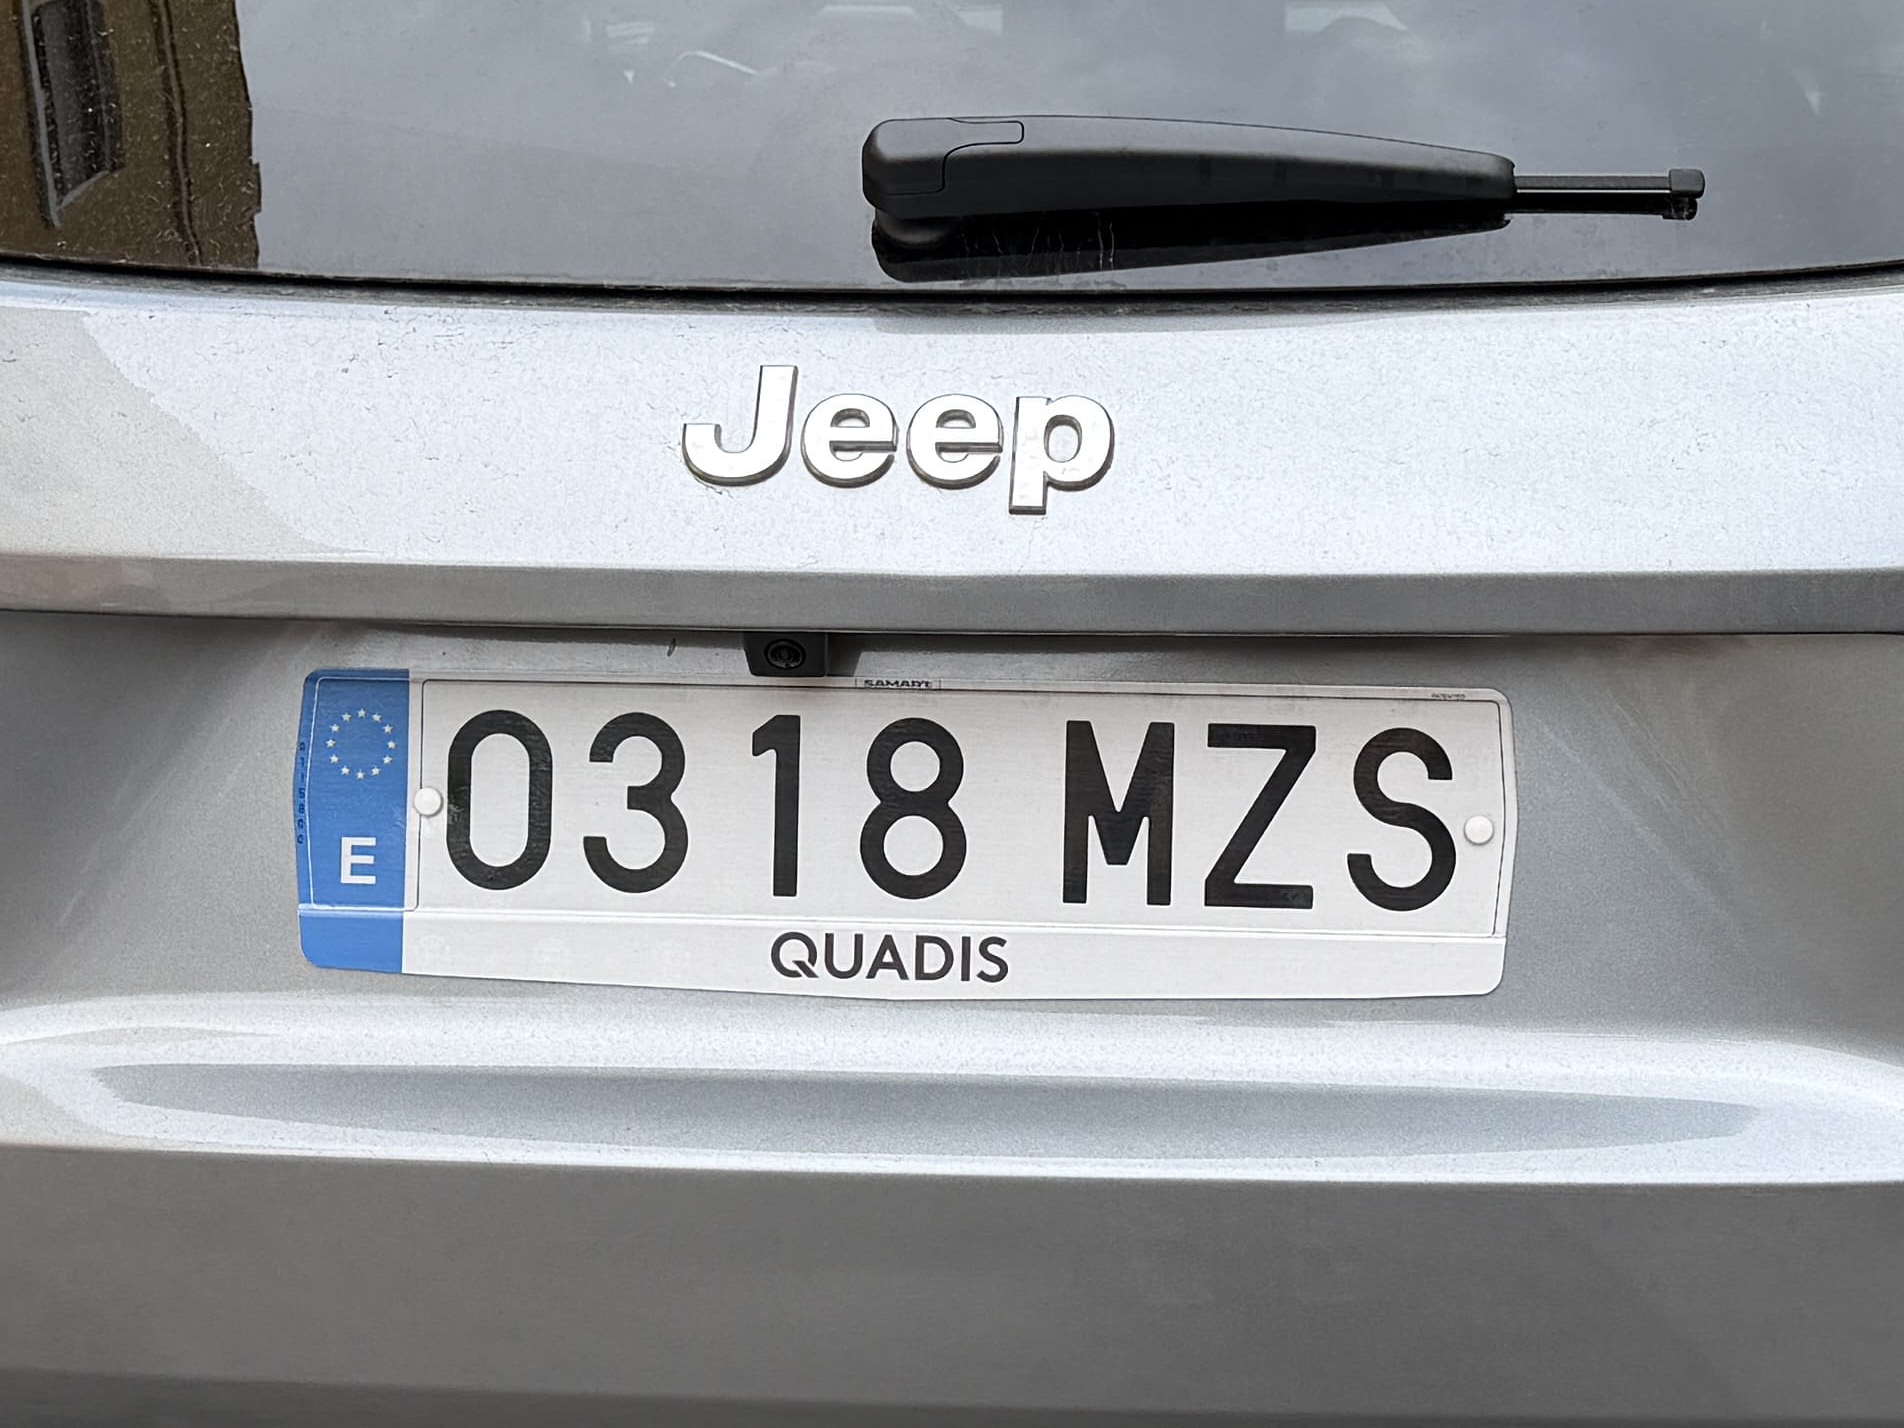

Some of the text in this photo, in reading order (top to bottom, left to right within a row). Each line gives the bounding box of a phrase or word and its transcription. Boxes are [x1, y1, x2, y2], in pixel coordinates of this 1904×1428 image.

[681, 365, 1115, 515] Jeep
[340, 836, 377, 885] E
[446, 709, 1457, 912] 0318 MZS
[770, 931, 1009, 984] QUADIS
